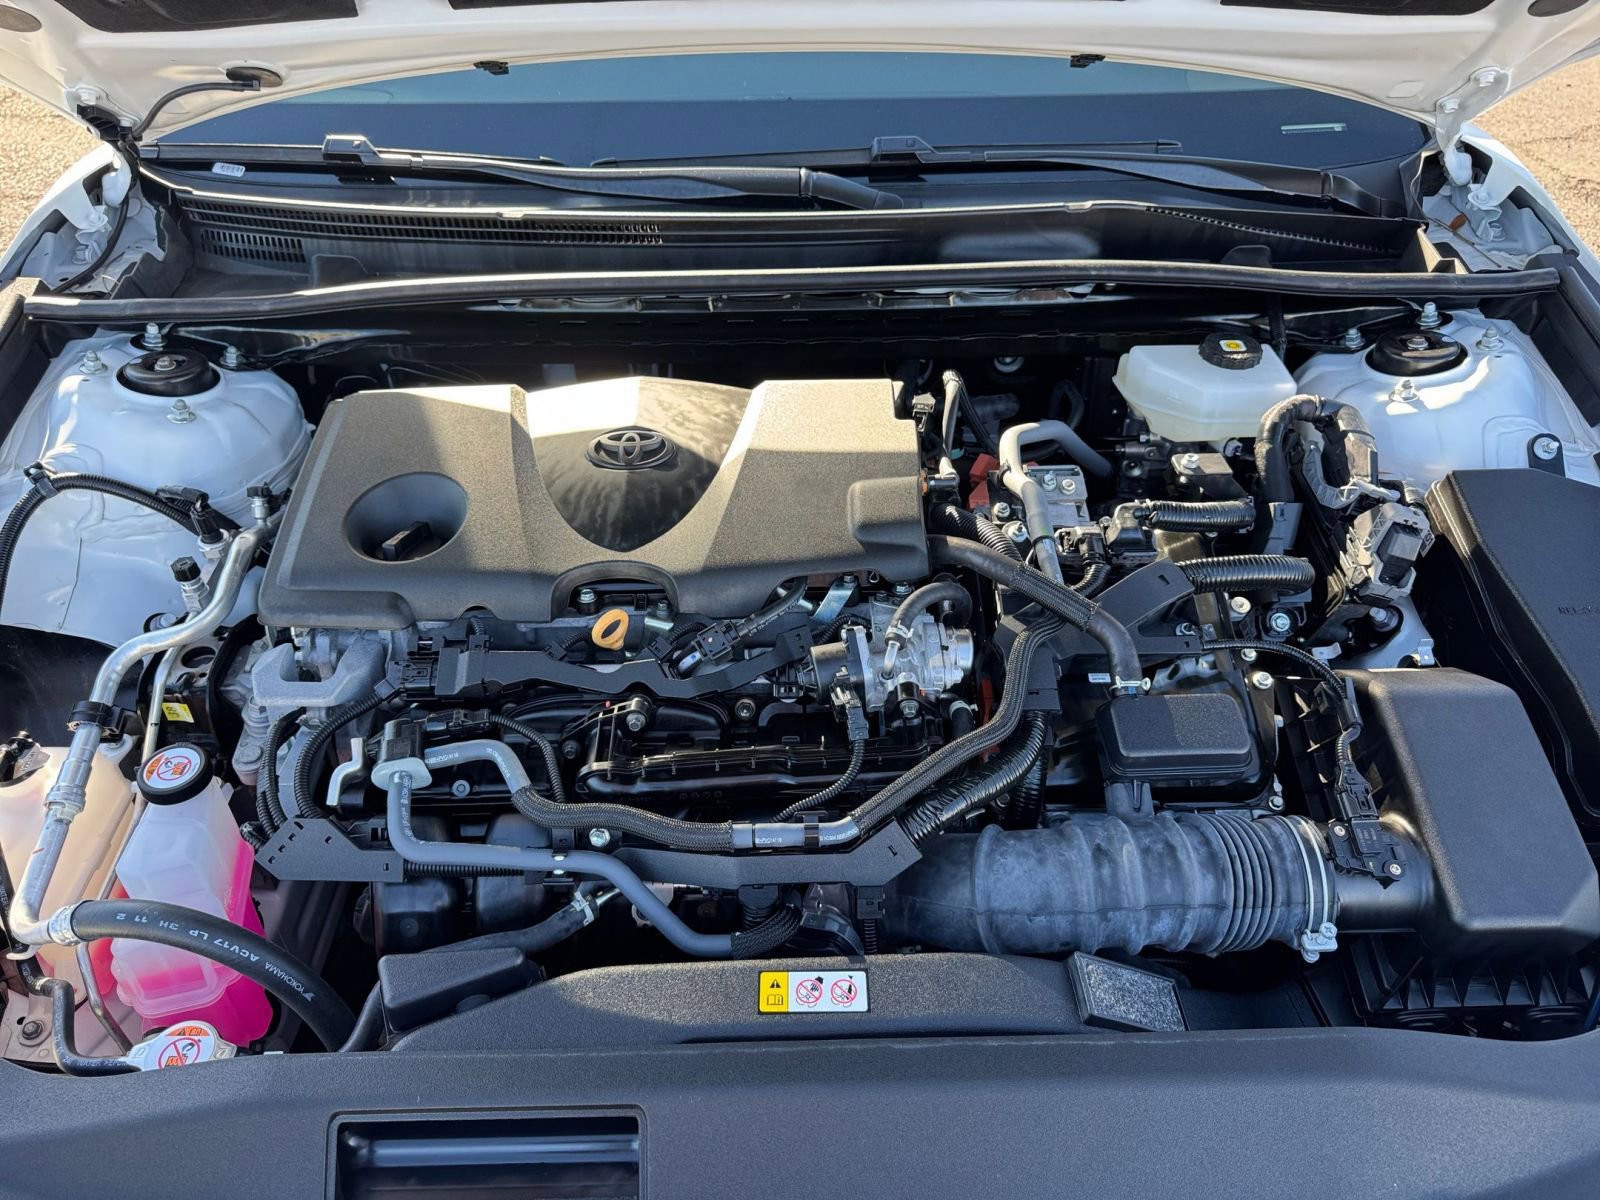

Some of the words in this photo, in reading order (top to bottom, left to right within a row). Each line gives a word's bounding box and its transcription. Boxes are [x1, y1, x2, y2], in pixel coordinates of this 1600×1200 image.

[116, 912, 126, 920] 2
[159, 920, 179, 931] 3H
[189, 929, 209, 941] LP
[213, 938, 260, 962] ACV17
[265, 962, 305, 993] YOKOHAMA
